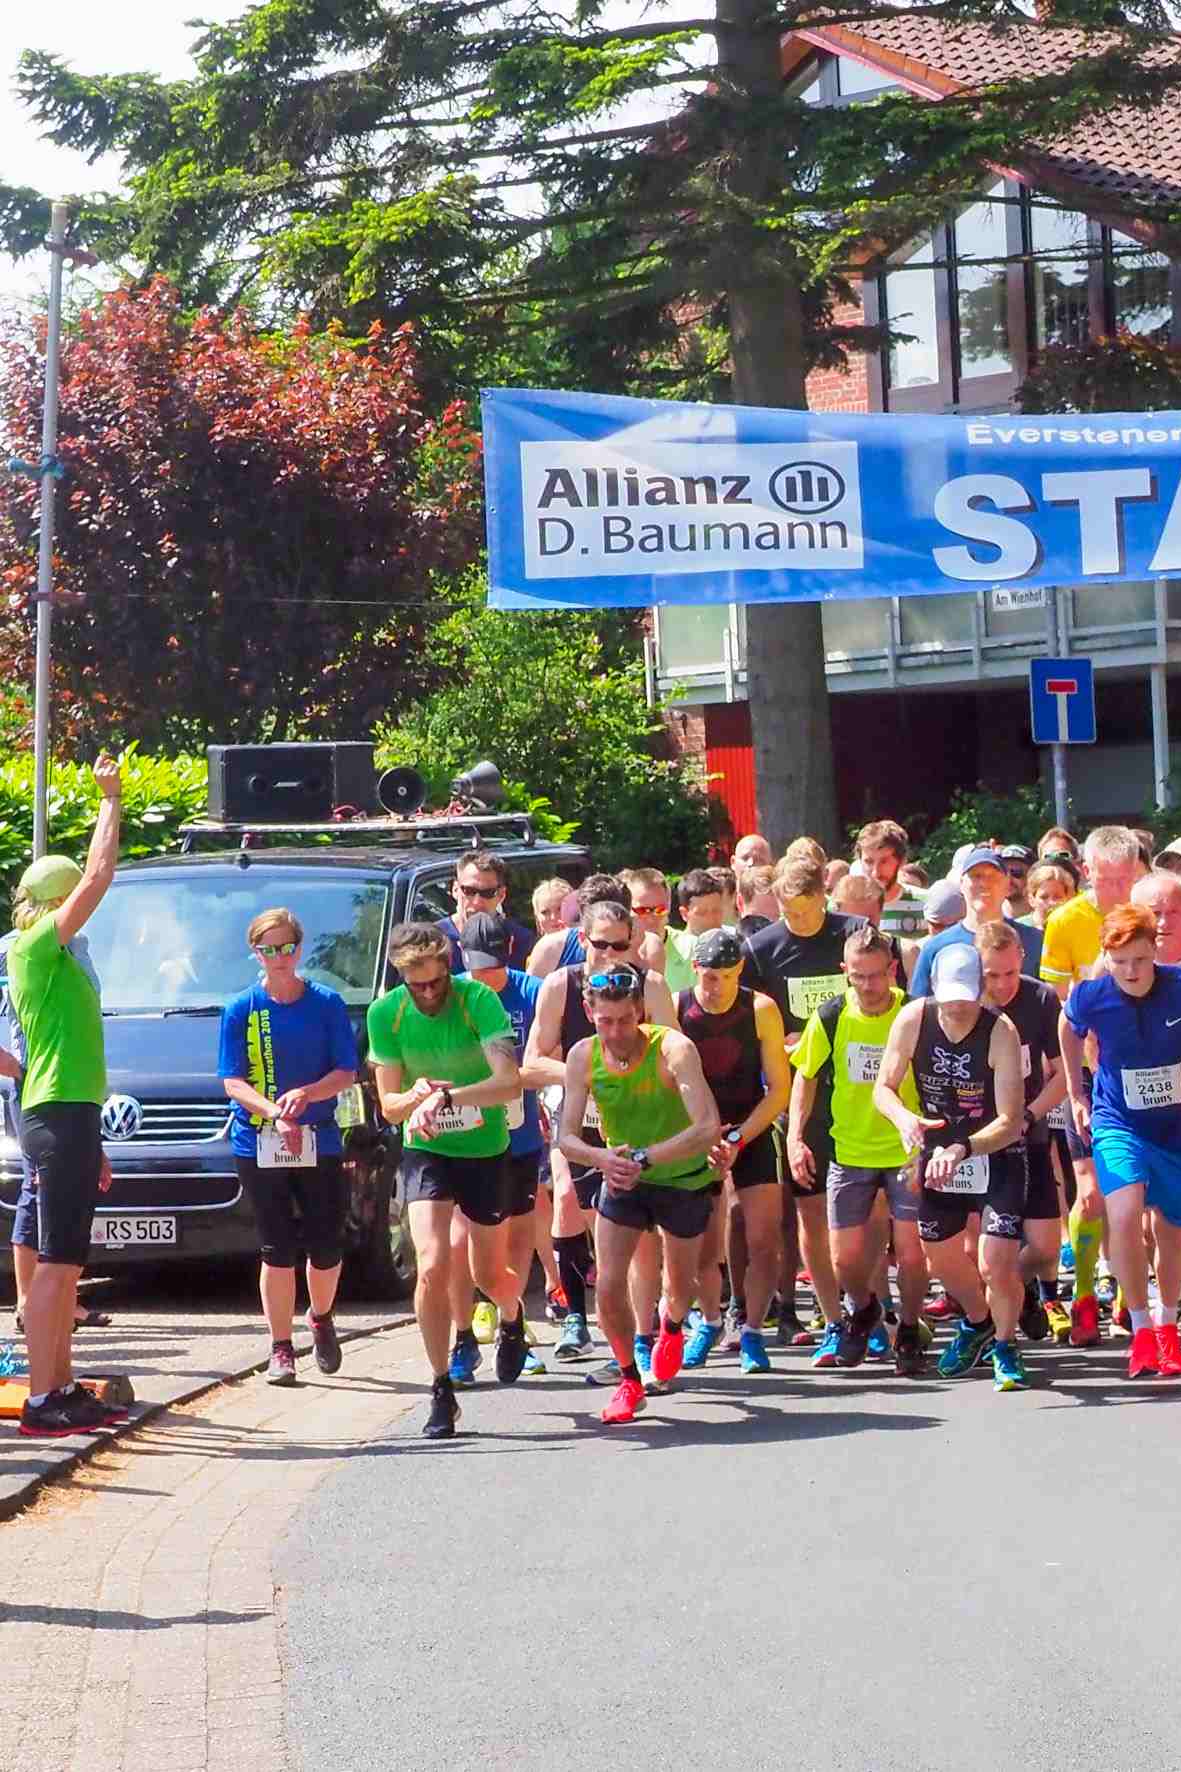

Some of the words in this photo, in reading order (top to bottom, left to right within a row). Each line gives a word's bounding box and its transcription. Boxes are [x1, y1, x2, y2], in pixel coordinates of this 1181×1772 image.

[537, 467, 753, 509] Allianz
[537, 517, 588, 556] D.
[602, 515, 849, 554] Baumann
[864, 1060, 880, 1070] 45
[1137, 1081, 1173, 1095] 2438
[1142, 1095, 1173, 1106] bruns
[957, 1165, 974, 1177] 43
[106, 1220, 132, 1240] RS
[136, 1220, 174, 1240] 503
